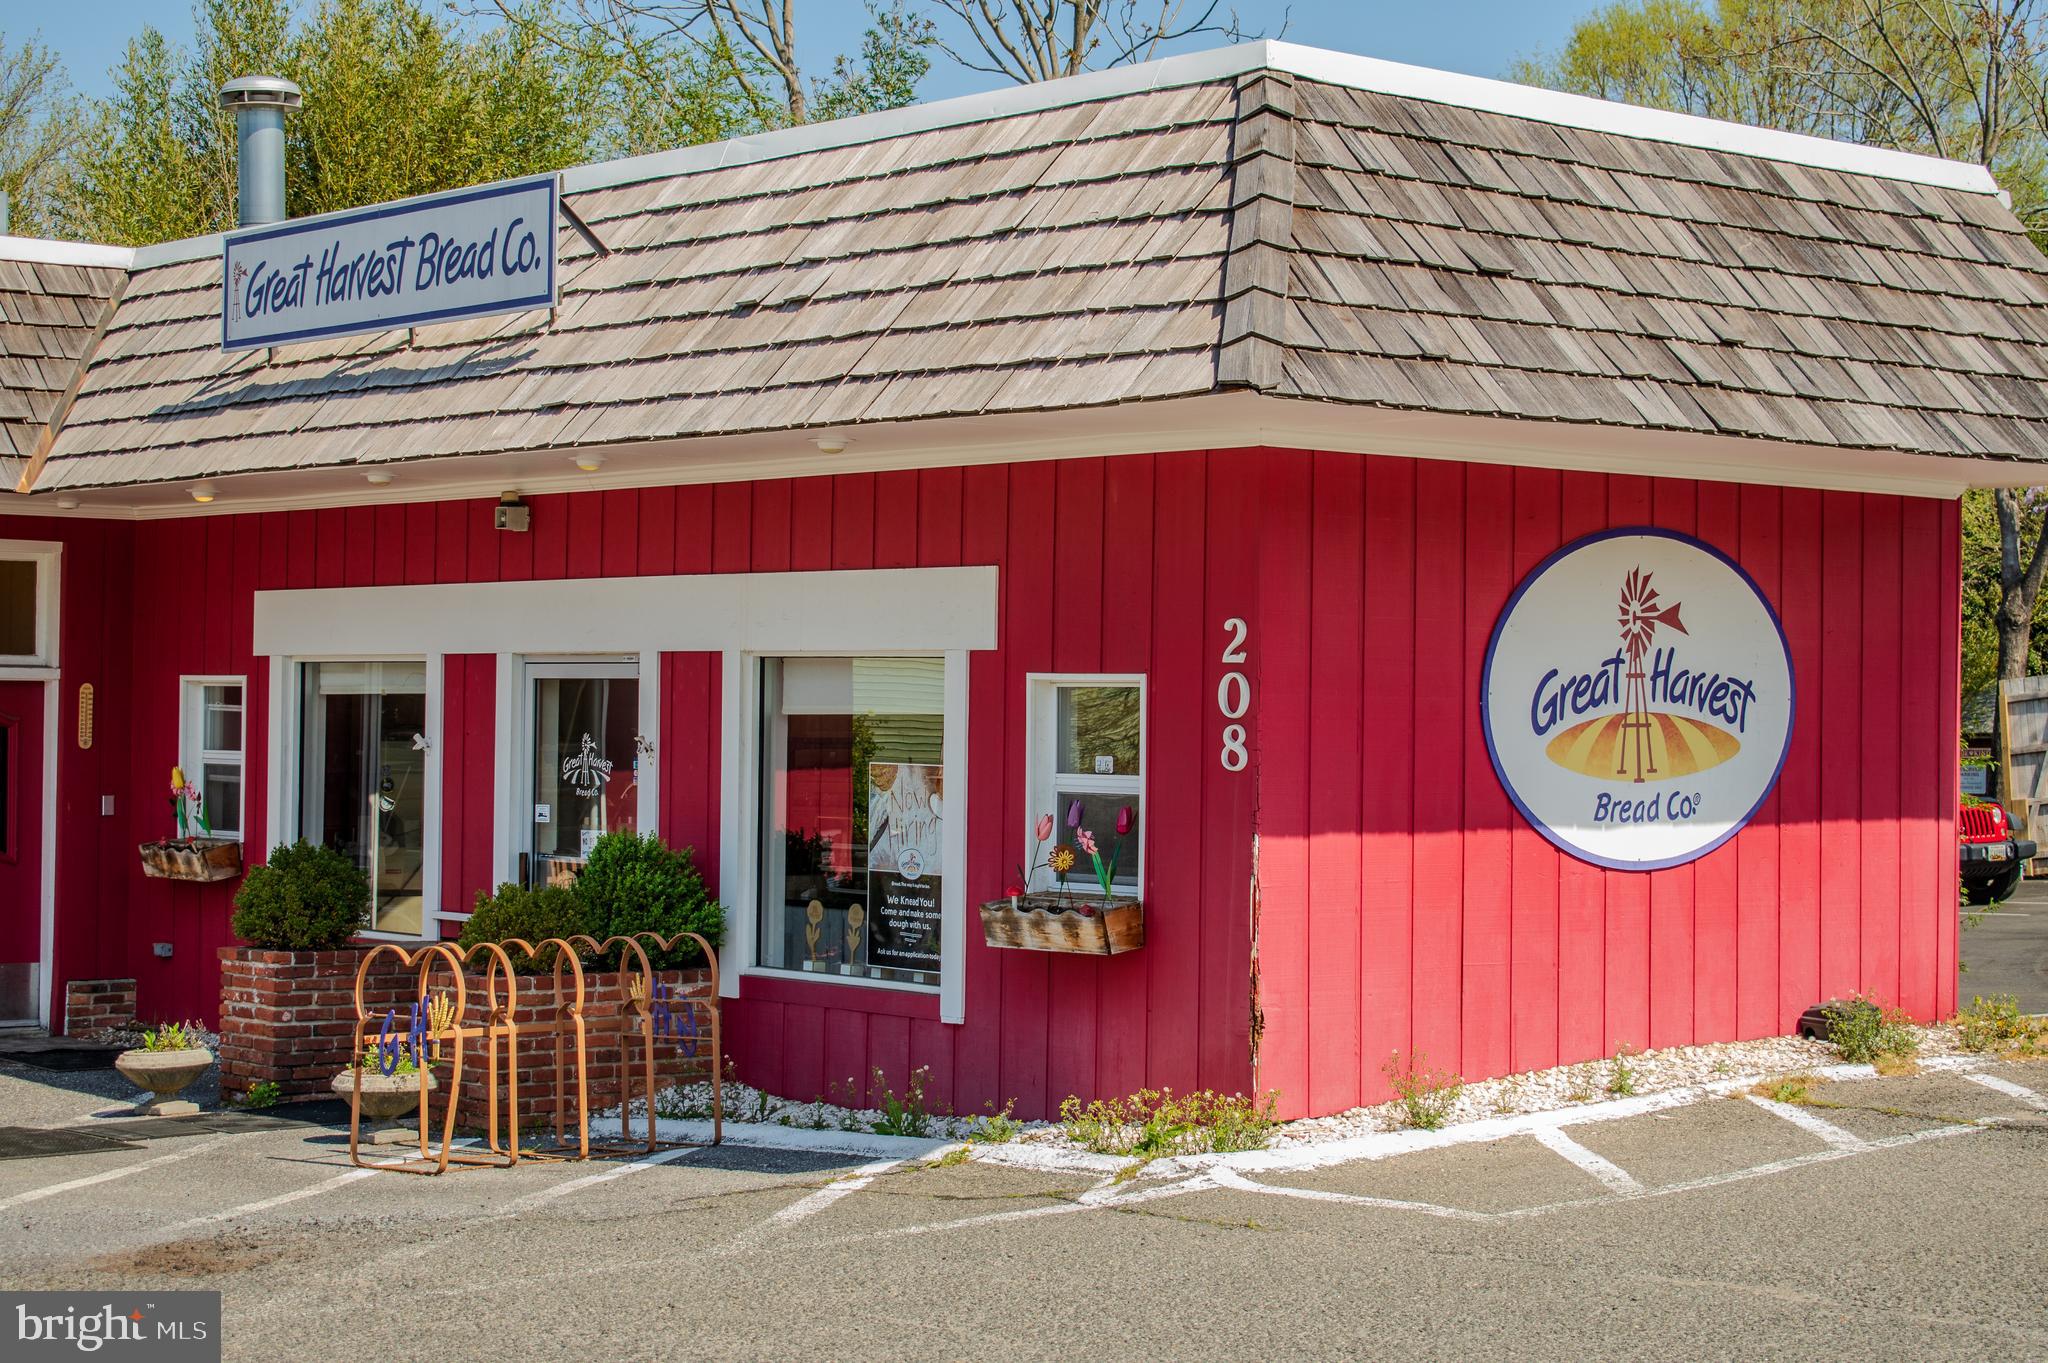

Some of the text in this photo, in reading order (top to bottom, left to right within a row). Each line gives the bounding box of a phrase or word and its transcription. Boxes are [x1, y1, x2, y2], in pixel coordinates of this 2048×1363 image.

[245, 217, 541, 318] Great Harvest Bread Co.
[1217, 616, 1250, 772] 208
[1530, 647, 1756, 736] Great Harvest
[562, 752, 614, 775] Great Harvest
[890, 786, 928, 814] Now
[1593, 792, 1660, 823] Bread
[887, 815, 938, 857] Hiring
[880, 907, 897, 916] Come
[898, 908, 910, 917] and
[910, 910, 924, 918] make
[886, 895, 935, 907] We Knead You!
[888, 919, 931, 930] dough with us.
